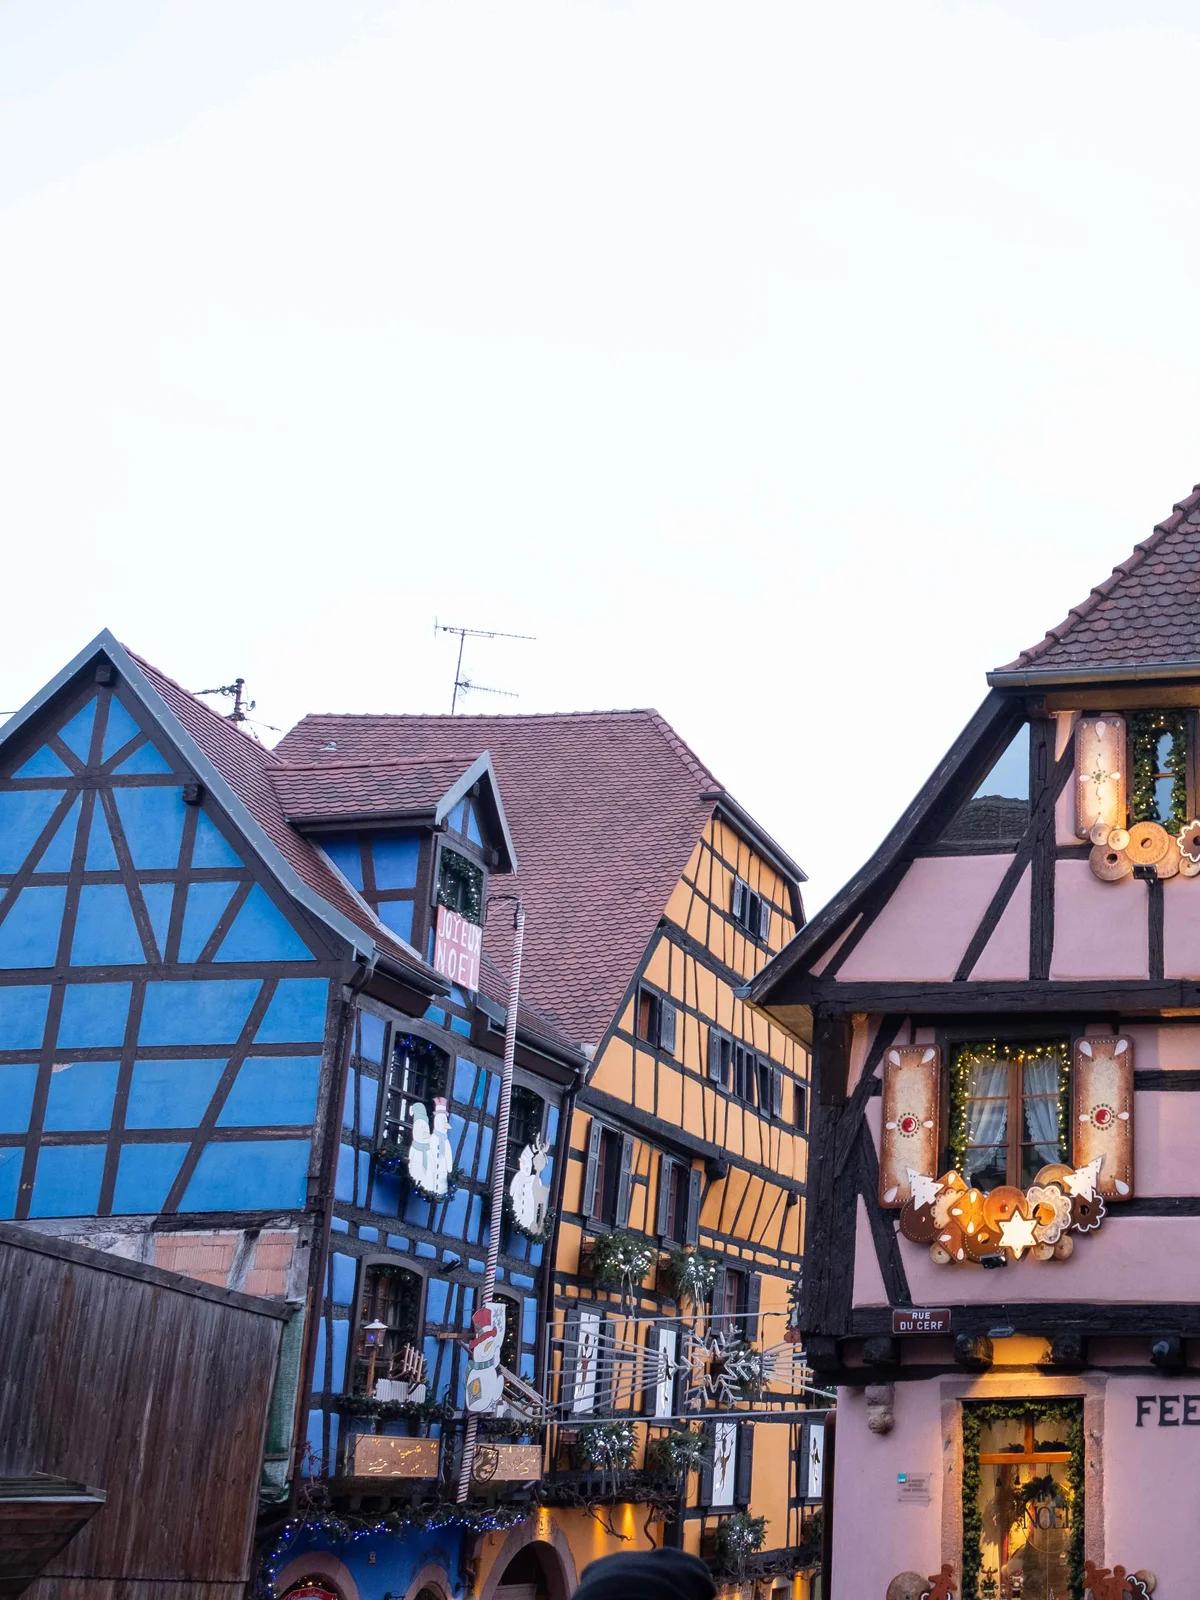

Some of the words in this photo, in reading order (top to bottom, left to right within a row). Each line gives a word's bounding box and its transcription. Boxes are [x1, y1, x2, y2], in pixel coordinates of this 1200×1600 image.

[438, 909, 481, 956] JOYEUX
[436, 939, 480, 990] NOEL
[899, 1321, 914, 1331] DU
[916, 1320, 944, 1330] CERF
[911, 1311, 931, 1320] RUE
